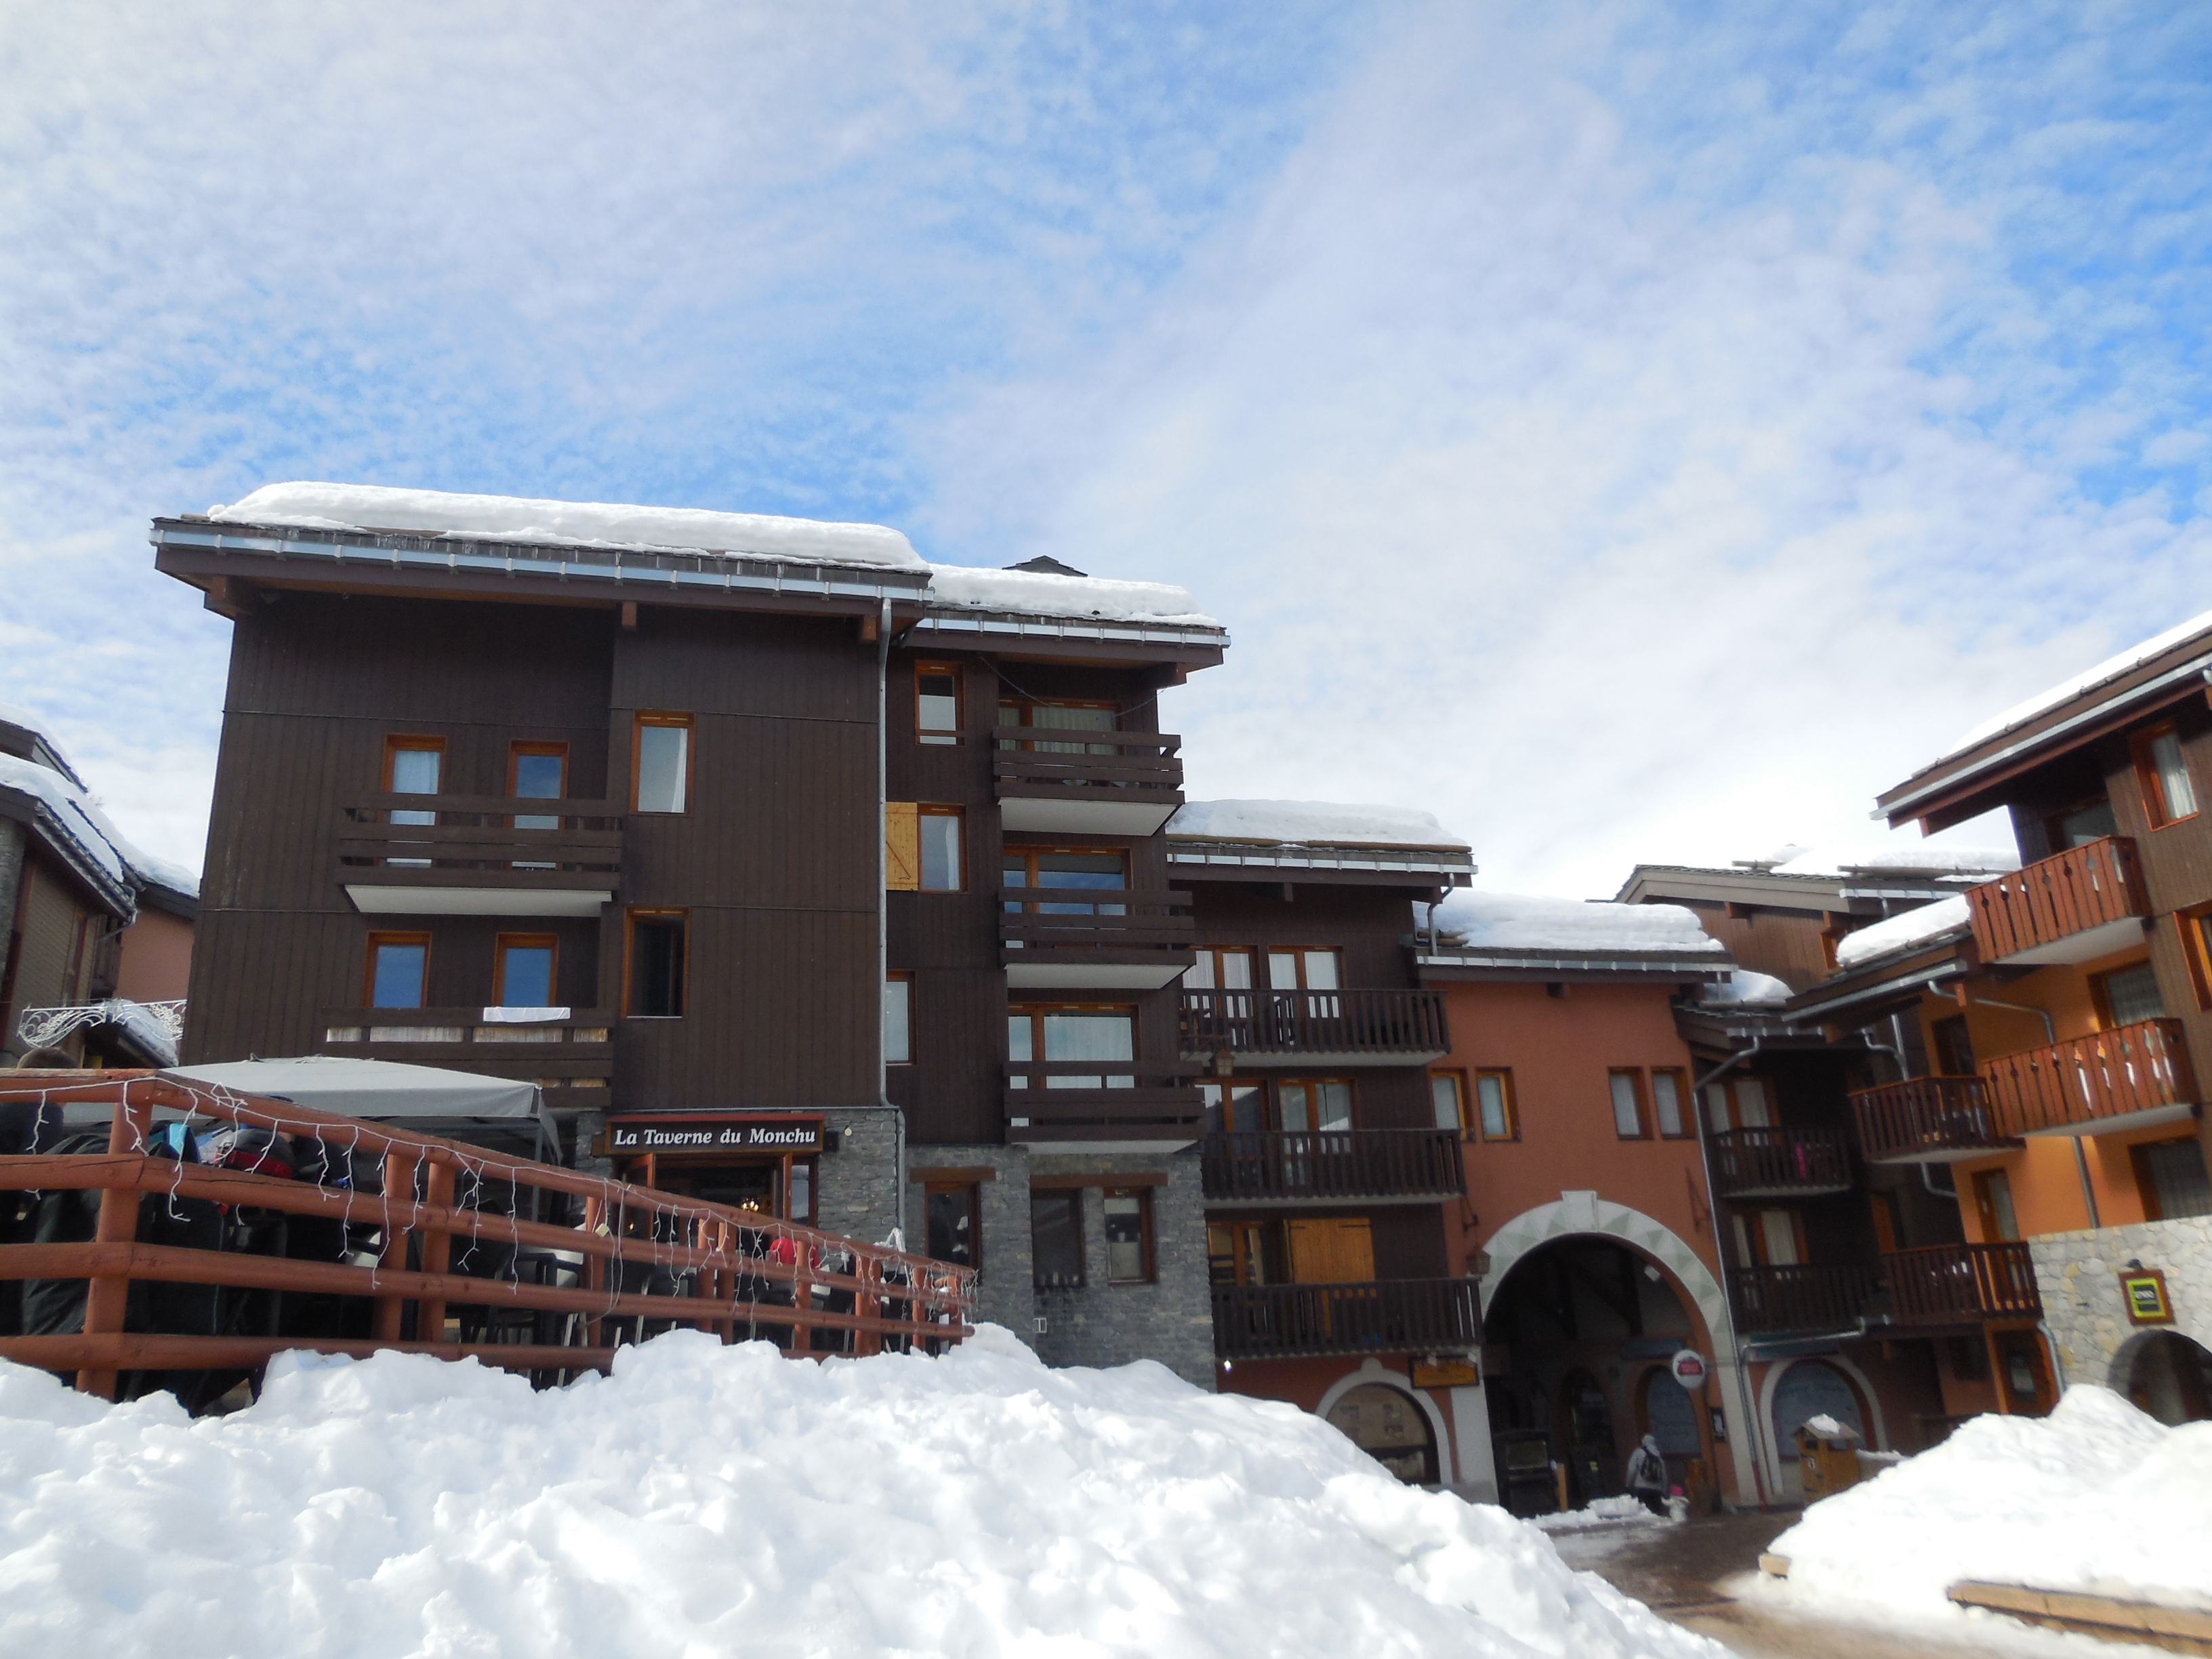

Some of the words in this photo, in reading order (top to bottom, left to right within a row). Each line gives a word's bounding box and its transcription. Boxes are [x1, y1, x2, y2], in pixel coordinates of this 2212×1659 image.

[615, 1129, 637, 1145] La
[644, 1129, 712, 1145] Taverne
[720, 1128, 741, 1144] du
[749, 1128, 815, 1143] Monchu
